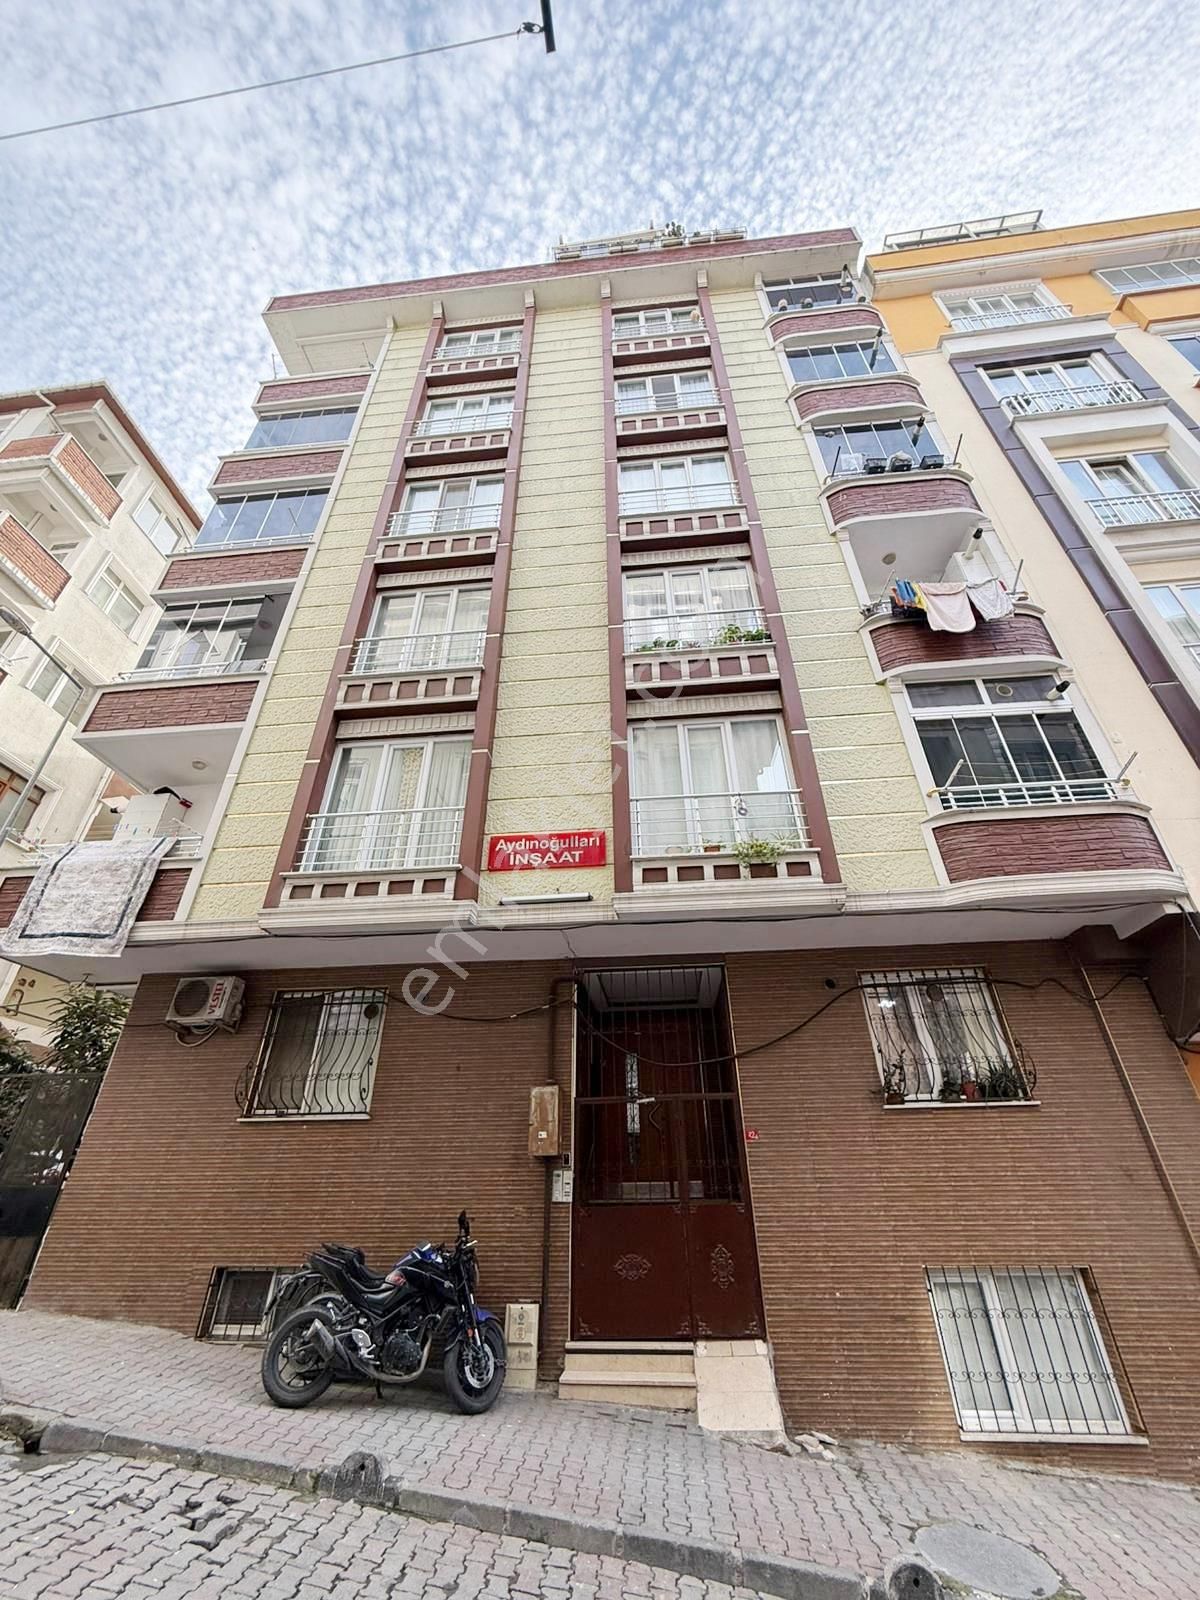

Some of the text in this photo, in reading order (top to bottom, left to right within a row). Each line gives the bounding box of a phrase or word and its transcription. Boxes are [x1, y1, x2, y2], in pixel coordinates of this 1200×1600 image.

[495, 836, 600, 853] Aydınoğulları
[509, 851, 584, 867] İNŞAAT
[208, 982, 225, 1015] VESTEL
